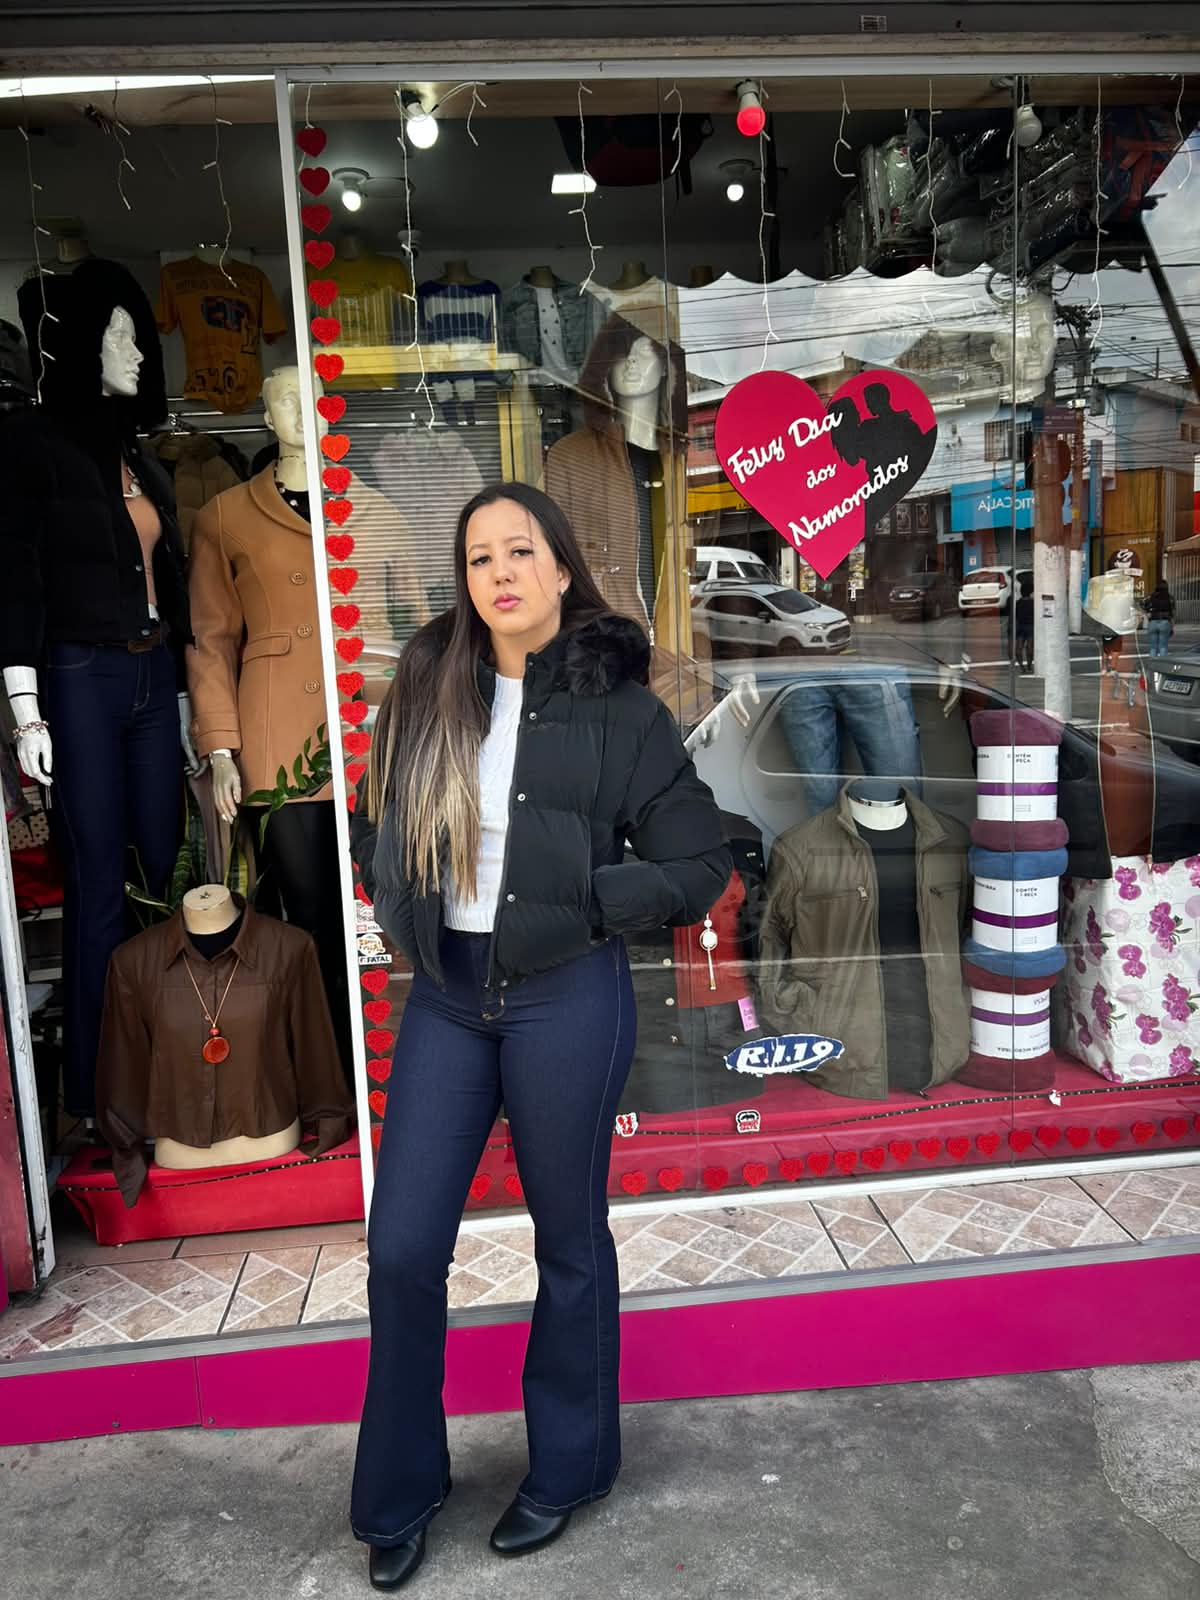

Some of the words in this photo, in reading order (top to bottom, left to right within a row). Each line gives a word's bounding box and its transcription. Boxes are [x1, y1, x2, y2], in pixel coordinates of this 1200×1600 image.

[727, 436, 785, 484] Feliz
[788, 411, 843, 447] Dia
[806, 463, 837, 489] dos
[788, 455, 909, 546] Namorados
